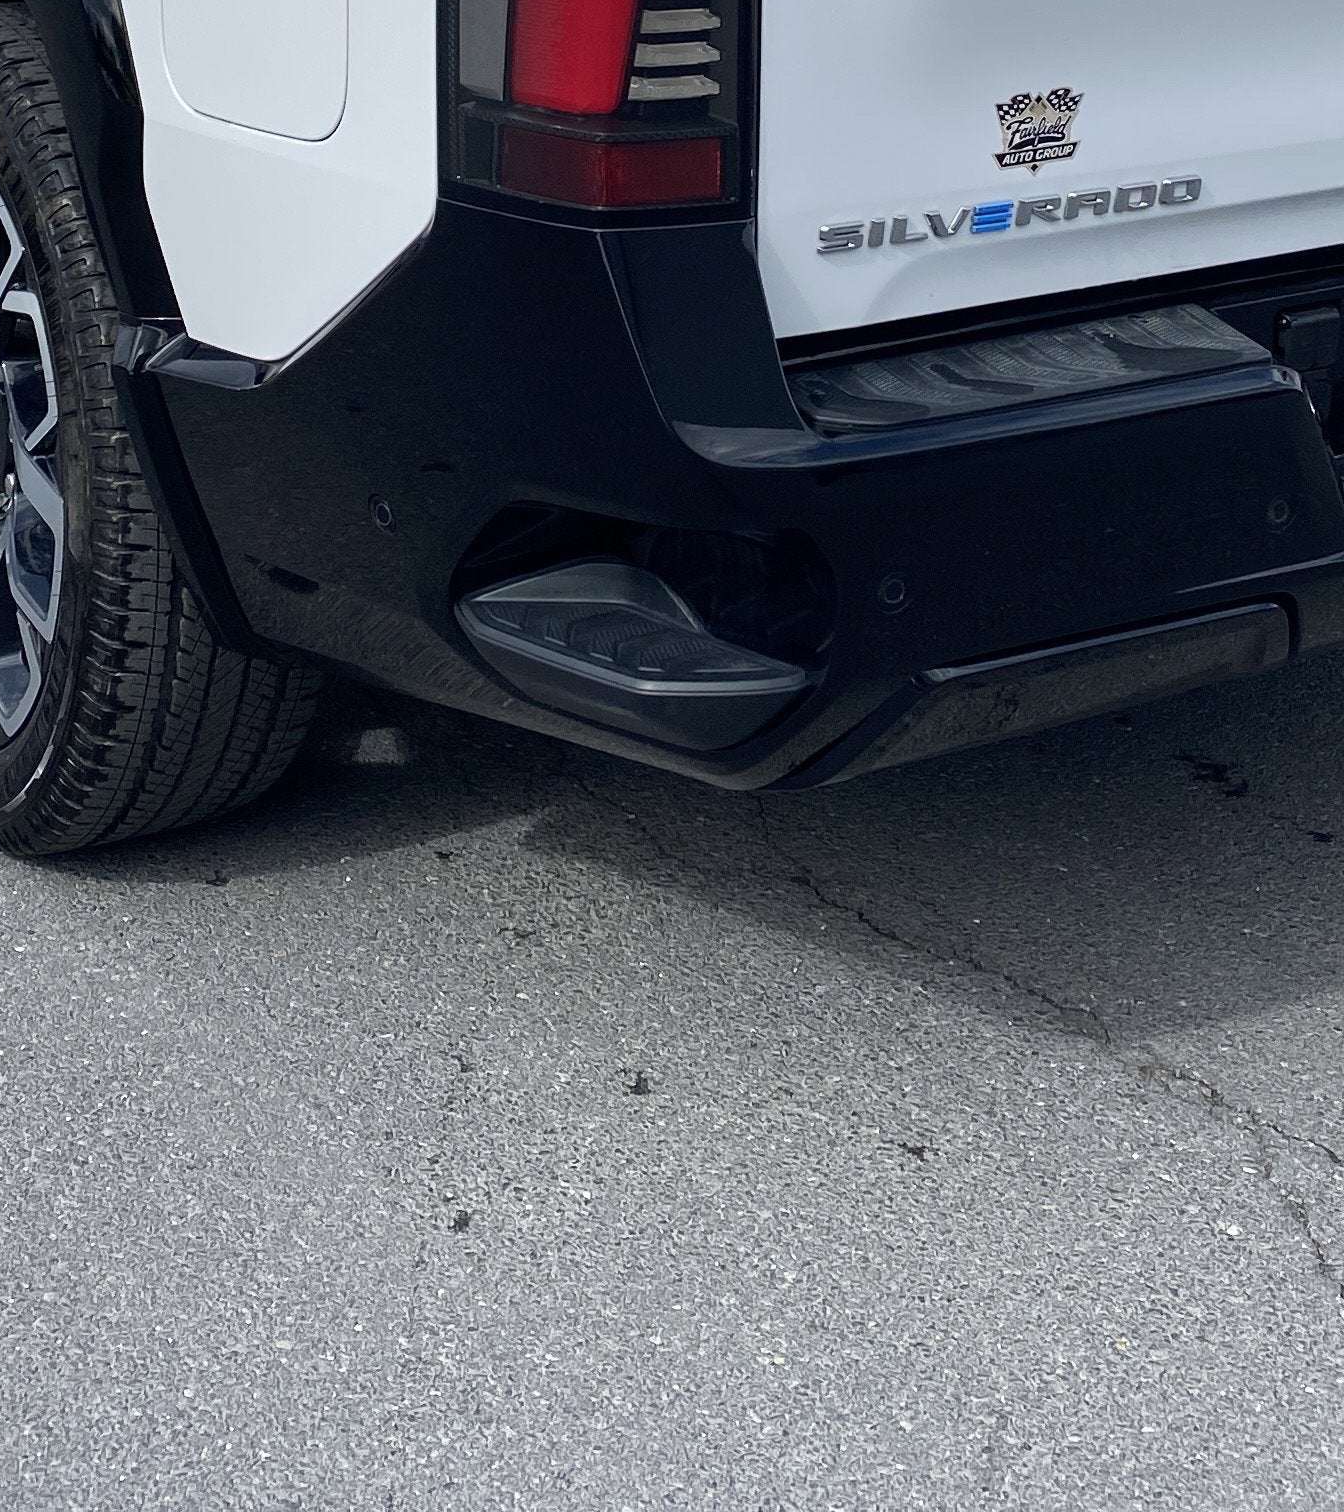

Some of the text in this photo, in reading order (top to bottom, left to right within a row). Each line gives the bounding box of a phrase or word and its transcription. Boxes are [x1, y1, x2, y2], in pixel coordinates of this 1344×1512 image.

[1005, 115, 1072, 149] Fairfield
[1002, 145, 1074, 166] AUTO GROUP
[816, 174, 1203, 255] SILVERADO
